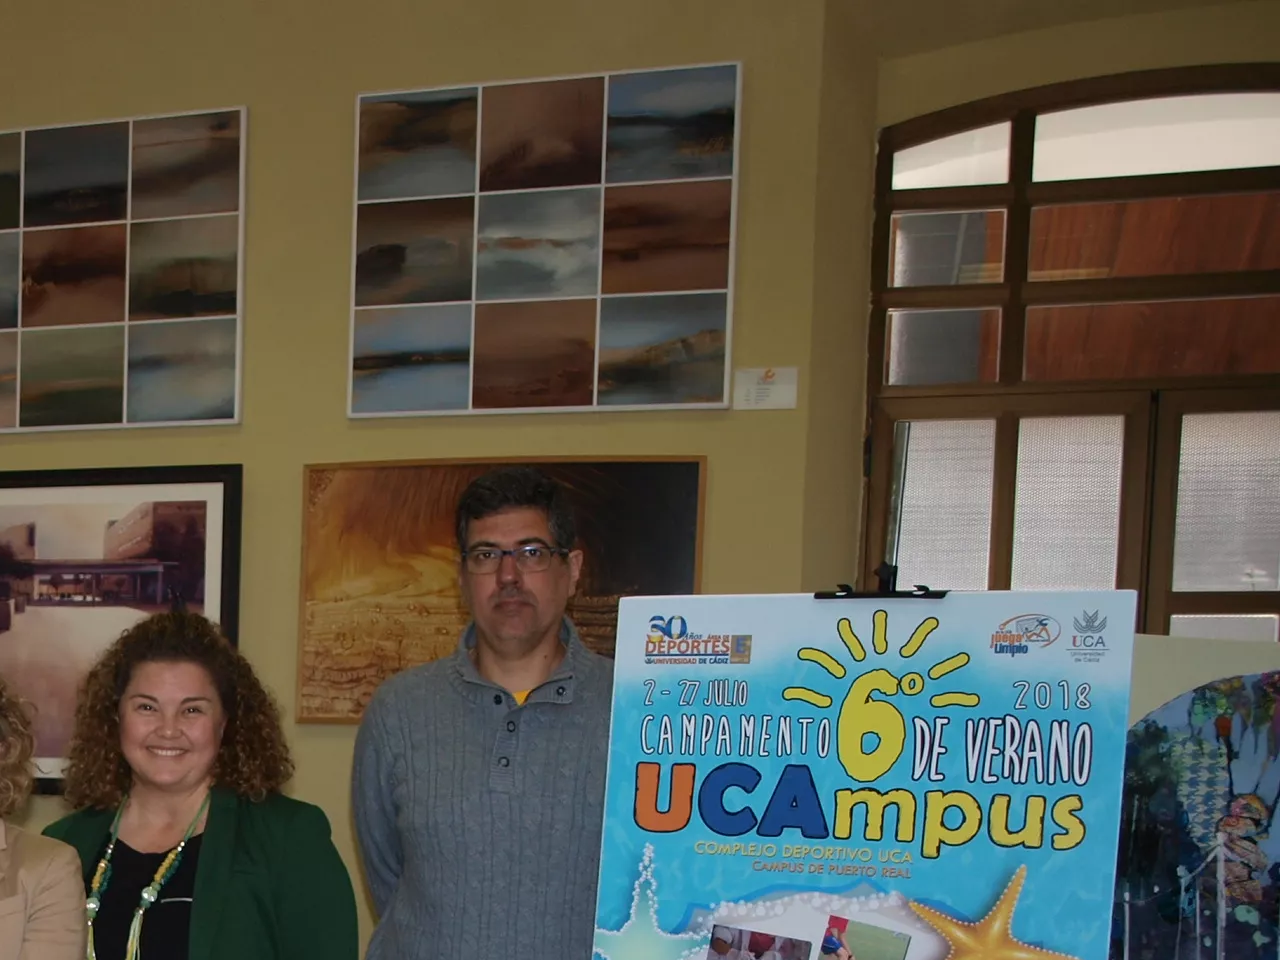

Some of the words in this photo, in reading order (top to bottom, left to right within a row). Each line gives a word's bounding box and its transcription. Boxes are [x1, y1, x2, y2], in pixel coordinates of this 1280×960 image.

[645, 640, 730, 654] DEPORTES
[1072, 635, 1106, 648] UCA
[643, 679, 656, 706] 2
[677, 679, 700, 707] 27
[702, 679, 749, 707] JULIO
[1012, 680, 1092, 710] 2018
[640, 714, 831, 758] CAMPAMENTO
[911, 717, 947, 783] DE
[965, 713, 1093, 786] VERANO
[633, 761, 1086, 859] UCAmpus
[694, 840, 777, 858] COMPLEJO
[781, 843, 873, 862] DEPORTIVO
[878, 848, 913, 864] UCA
[751, 860, 803, 875] CAMPUS
[807, 862, 826, 876] DE
[829, 863, 876, 878] PUERTO
[880, 865, 911, 879] REAL
